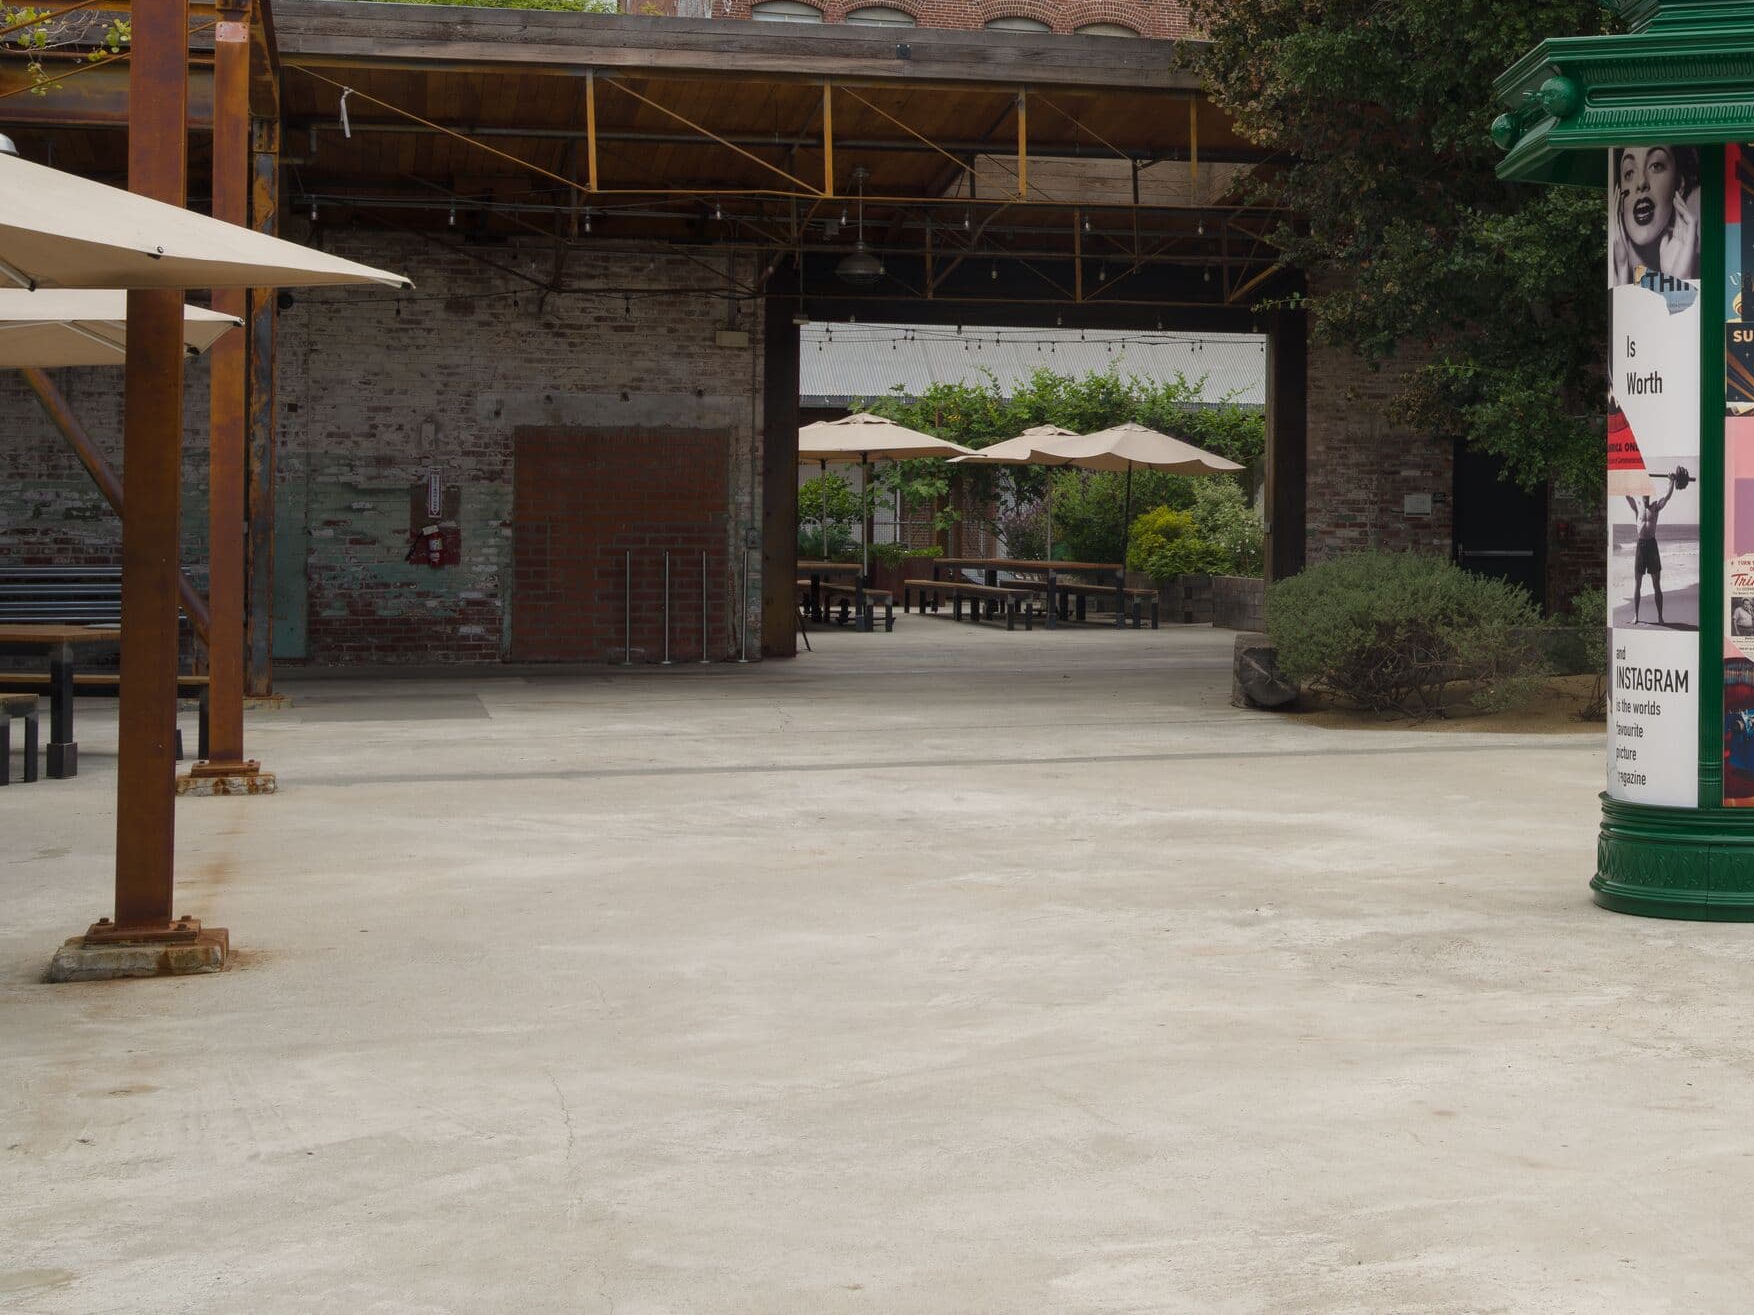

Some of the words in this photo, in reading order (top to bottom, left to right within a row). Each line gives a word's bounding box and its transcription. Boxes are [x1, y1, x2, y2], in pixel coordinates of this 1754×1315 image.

[1626, 335, 1636, 358] Is
[1626, 370, 1663, 395] Worth
[1616, 645, 1626, 660] and
[1616, 666, 1689, 694] INSTAGRAM
[1622, 698, 1631, 713] the
[1633, 700, 1661, 716] worlds
[1616, 745, 1637, 761] picture
